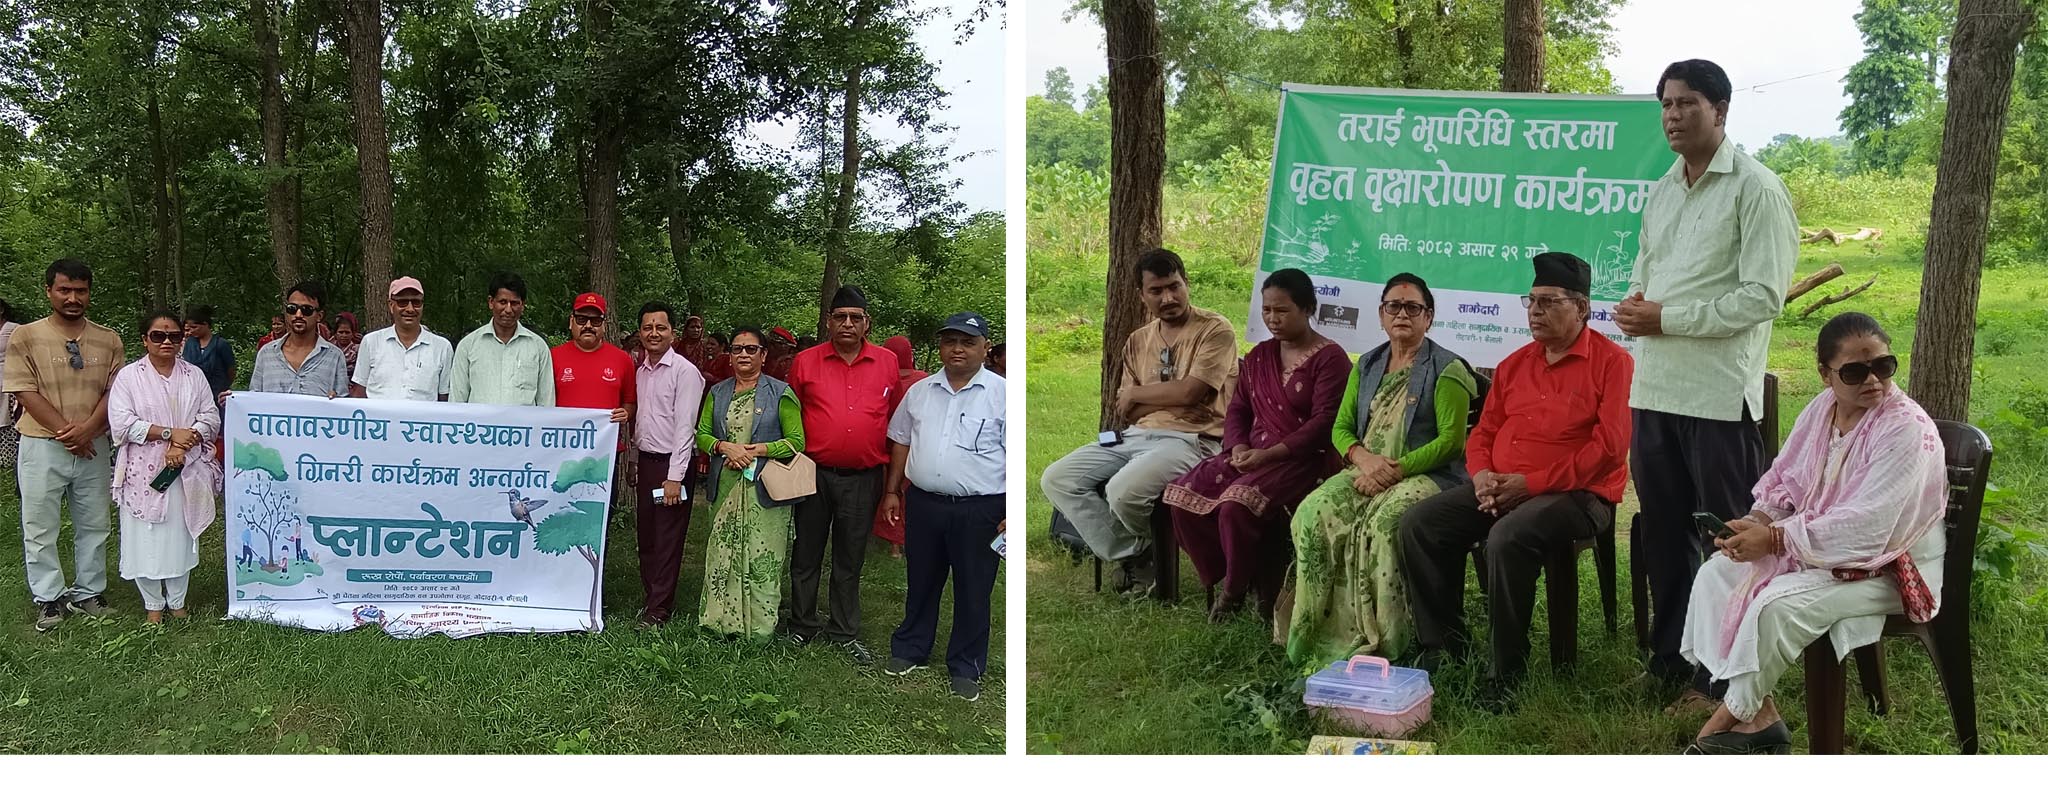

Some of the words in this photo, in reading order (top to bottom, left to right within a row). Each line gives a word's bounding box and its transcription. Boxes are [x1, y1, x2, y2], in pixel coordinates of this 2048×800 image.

[1338, 107, 1406, 148] तराई
[1411, 108, 1515, 153] भूपरिधि
[1523, 119, 1618, 151] स्तरमा
[1289, 162, 1357, 205] वृहत
[1364, 159, 1506, 213] वृक्षारोपण
[1417, 240, 1453, 257] २०८२
[1458, 242, 1496, 258] असार
[1501, 244, 1518, 261] २९
[247, 409, 390, 442] वातावरणीय
[400, 420, 533, 450] स्वास्थ्यका
[541, 419, 598, 451] लागी
[296, 453, 363, 484] ग्रिनरी
[372, 458, 460, 488] कार्यक्रम
[469, 462, 550, 490] अन्तर्गत
[307, 501, 529, 560] प्लान्टेशन
